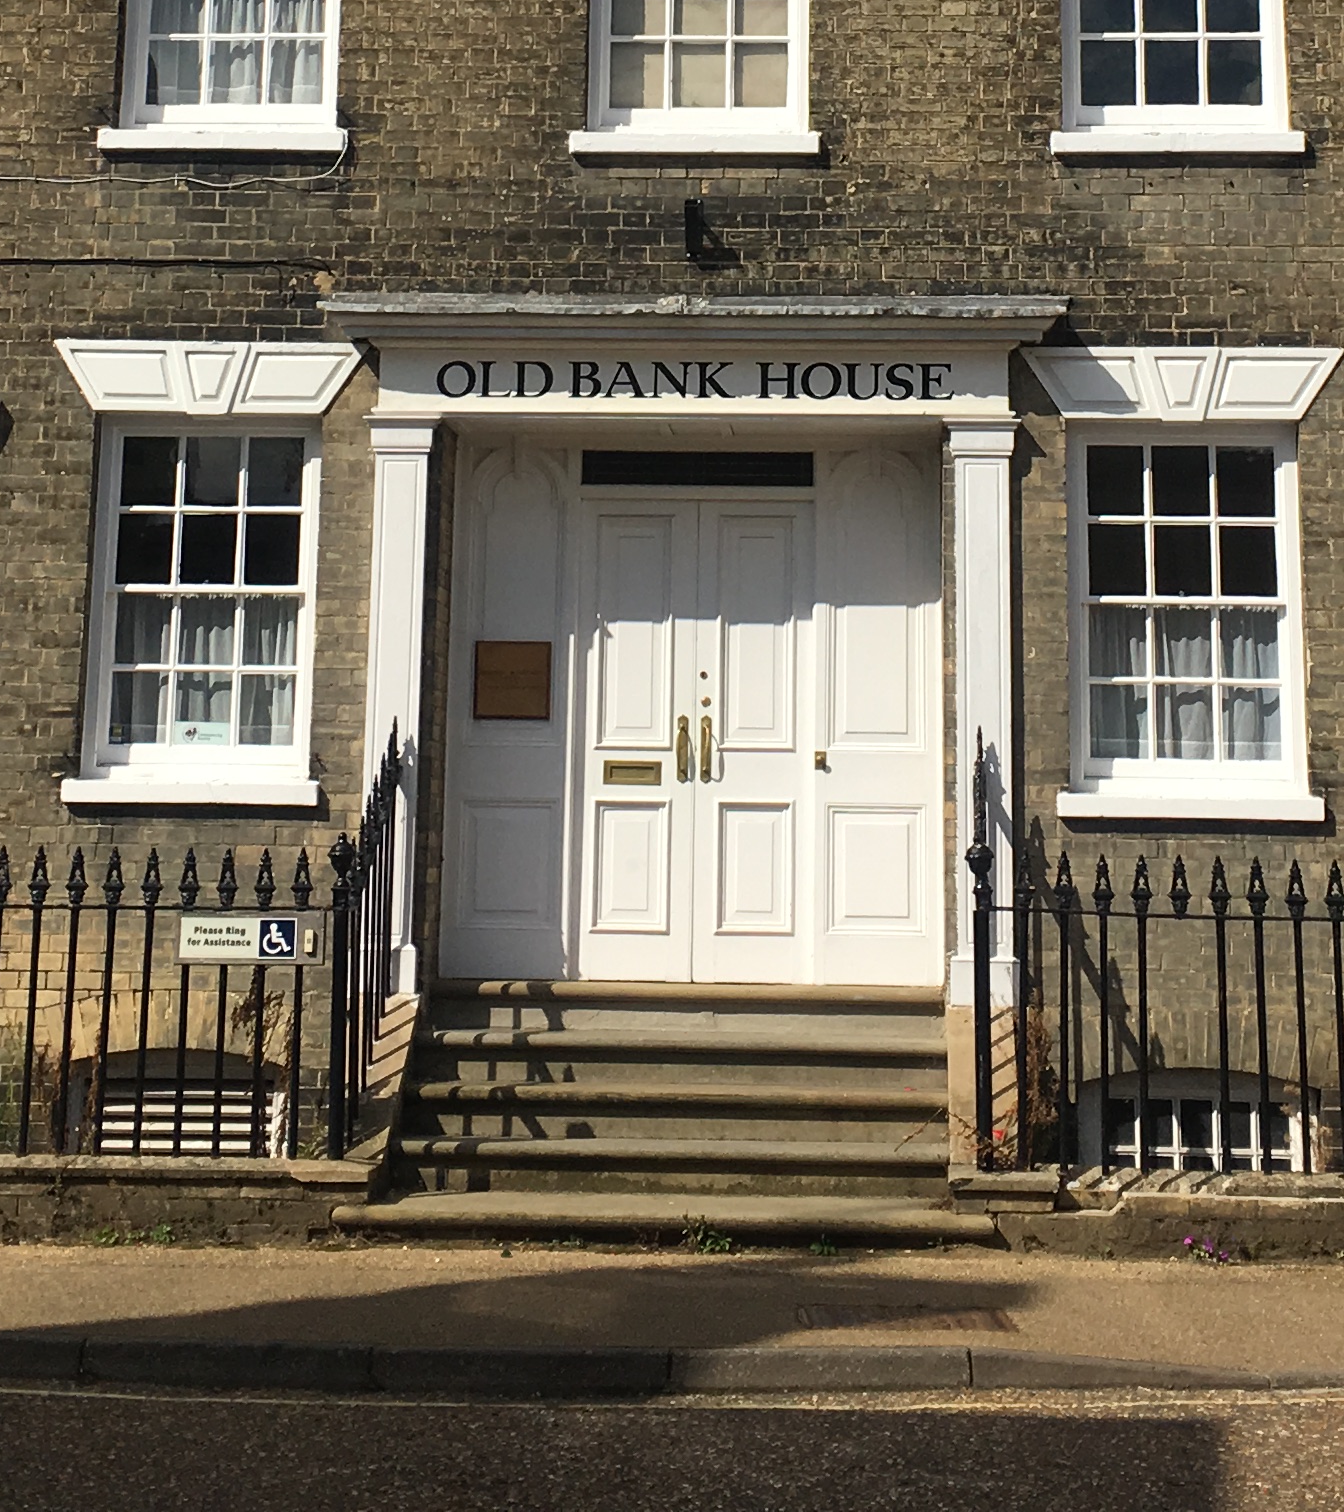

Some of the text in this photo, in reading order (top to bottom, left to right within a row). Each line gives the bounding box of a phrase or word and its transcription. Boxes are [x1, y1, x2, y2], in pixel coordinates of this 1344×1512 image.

[436, 360, 955, 400] OLD BANK HOUSE
[193, 926, 246, 937] Please Ring
[187, 938, 251, 947] for Assistance
